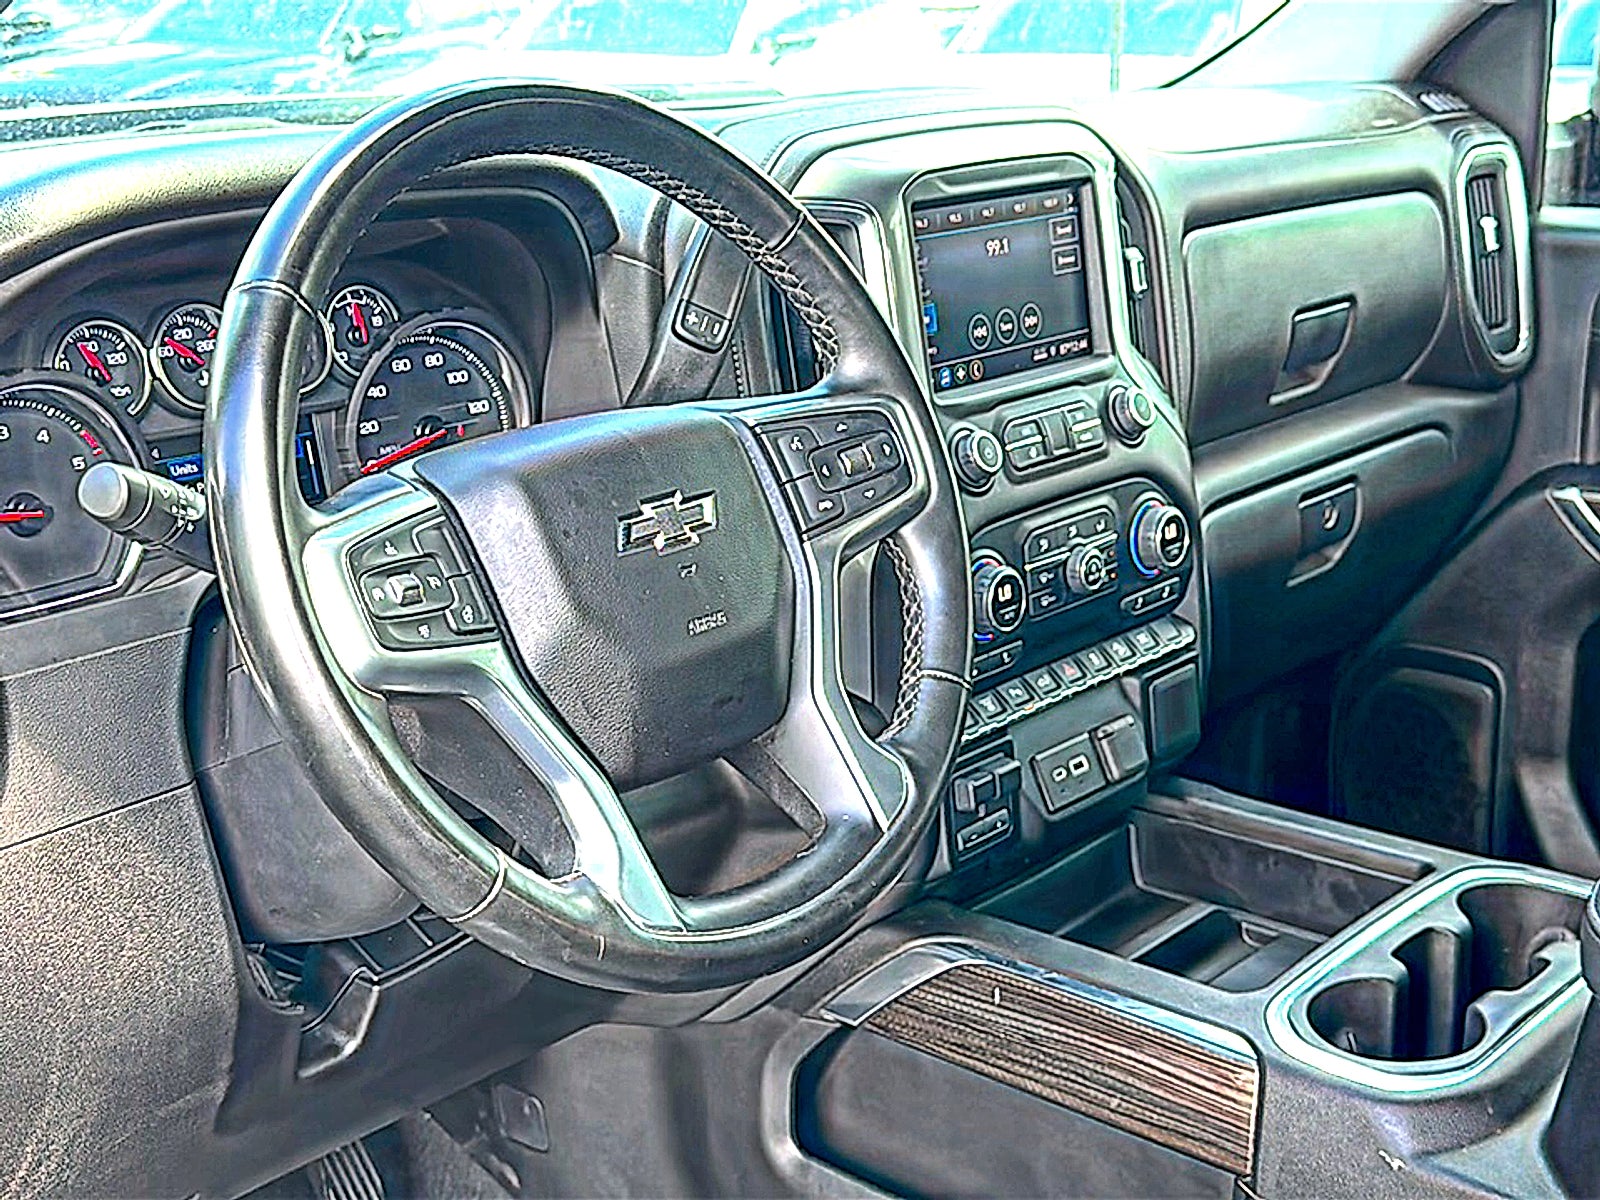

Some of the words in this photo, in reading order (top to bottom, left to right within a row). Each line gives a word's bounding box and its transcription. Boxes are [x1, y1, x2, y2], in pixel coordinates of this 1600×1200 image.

[986, 238, 1009, 255] 99.1
[173, 329, 192, 340] 210
[105, 352, 127, 365] 120
[392, 358, 411, 372] 60
[424, 353, 444, 367] 80
[446, 370, 468, 384] 100
[367, 385, 386, 398] 40
[467, 400, 490, 415] 120
[359, 420, 379, 435] 20
[36, 429, 50, 443] 4
[72, 456, 85, 470] 5
[170, 463, 199, 477] Units
